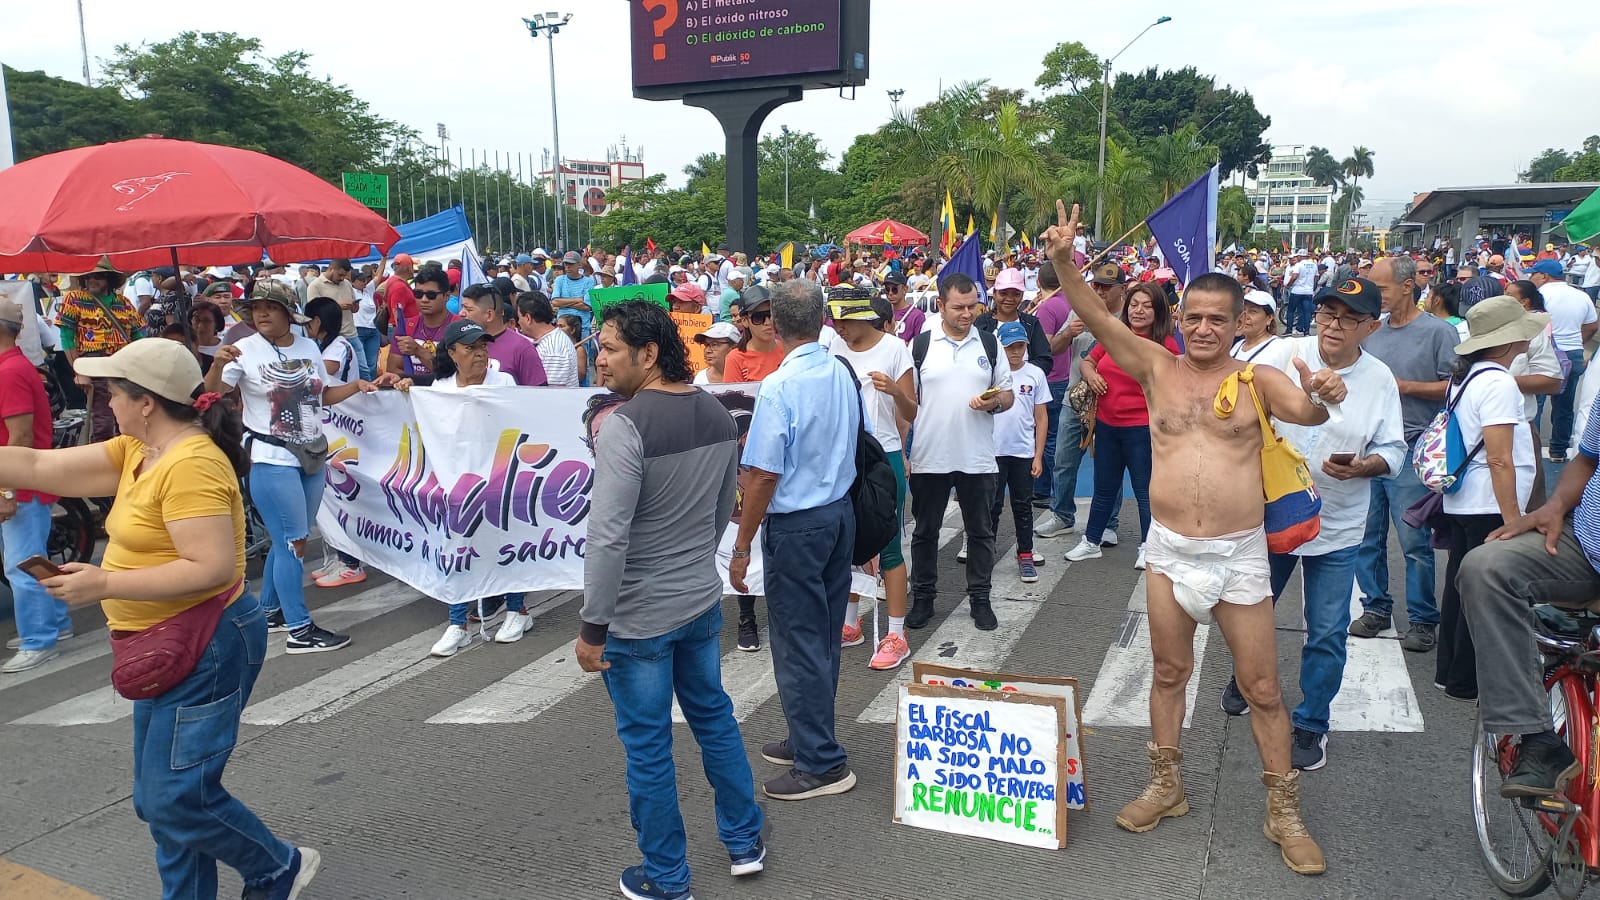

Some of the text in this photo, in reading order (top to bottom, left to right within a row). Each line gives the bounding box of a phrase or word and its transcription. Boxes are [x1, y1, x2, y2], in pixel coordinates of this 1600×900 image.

[686, 1, 698, 11] A)
[702, 0, 711, 8] El
[686, 9, 789, 28] B) El óxido nitroso
[686, 22, 825, 45] C) El dióxido de carbono
[356, 515, 414, 553] vamos
[908, 703, 928, 723] EL
[909, 725, 1032, 756] BARBOSA NO
[907, 741, 1046, 775] HA SIDO MALO
[907, 763, 920, 780] A
